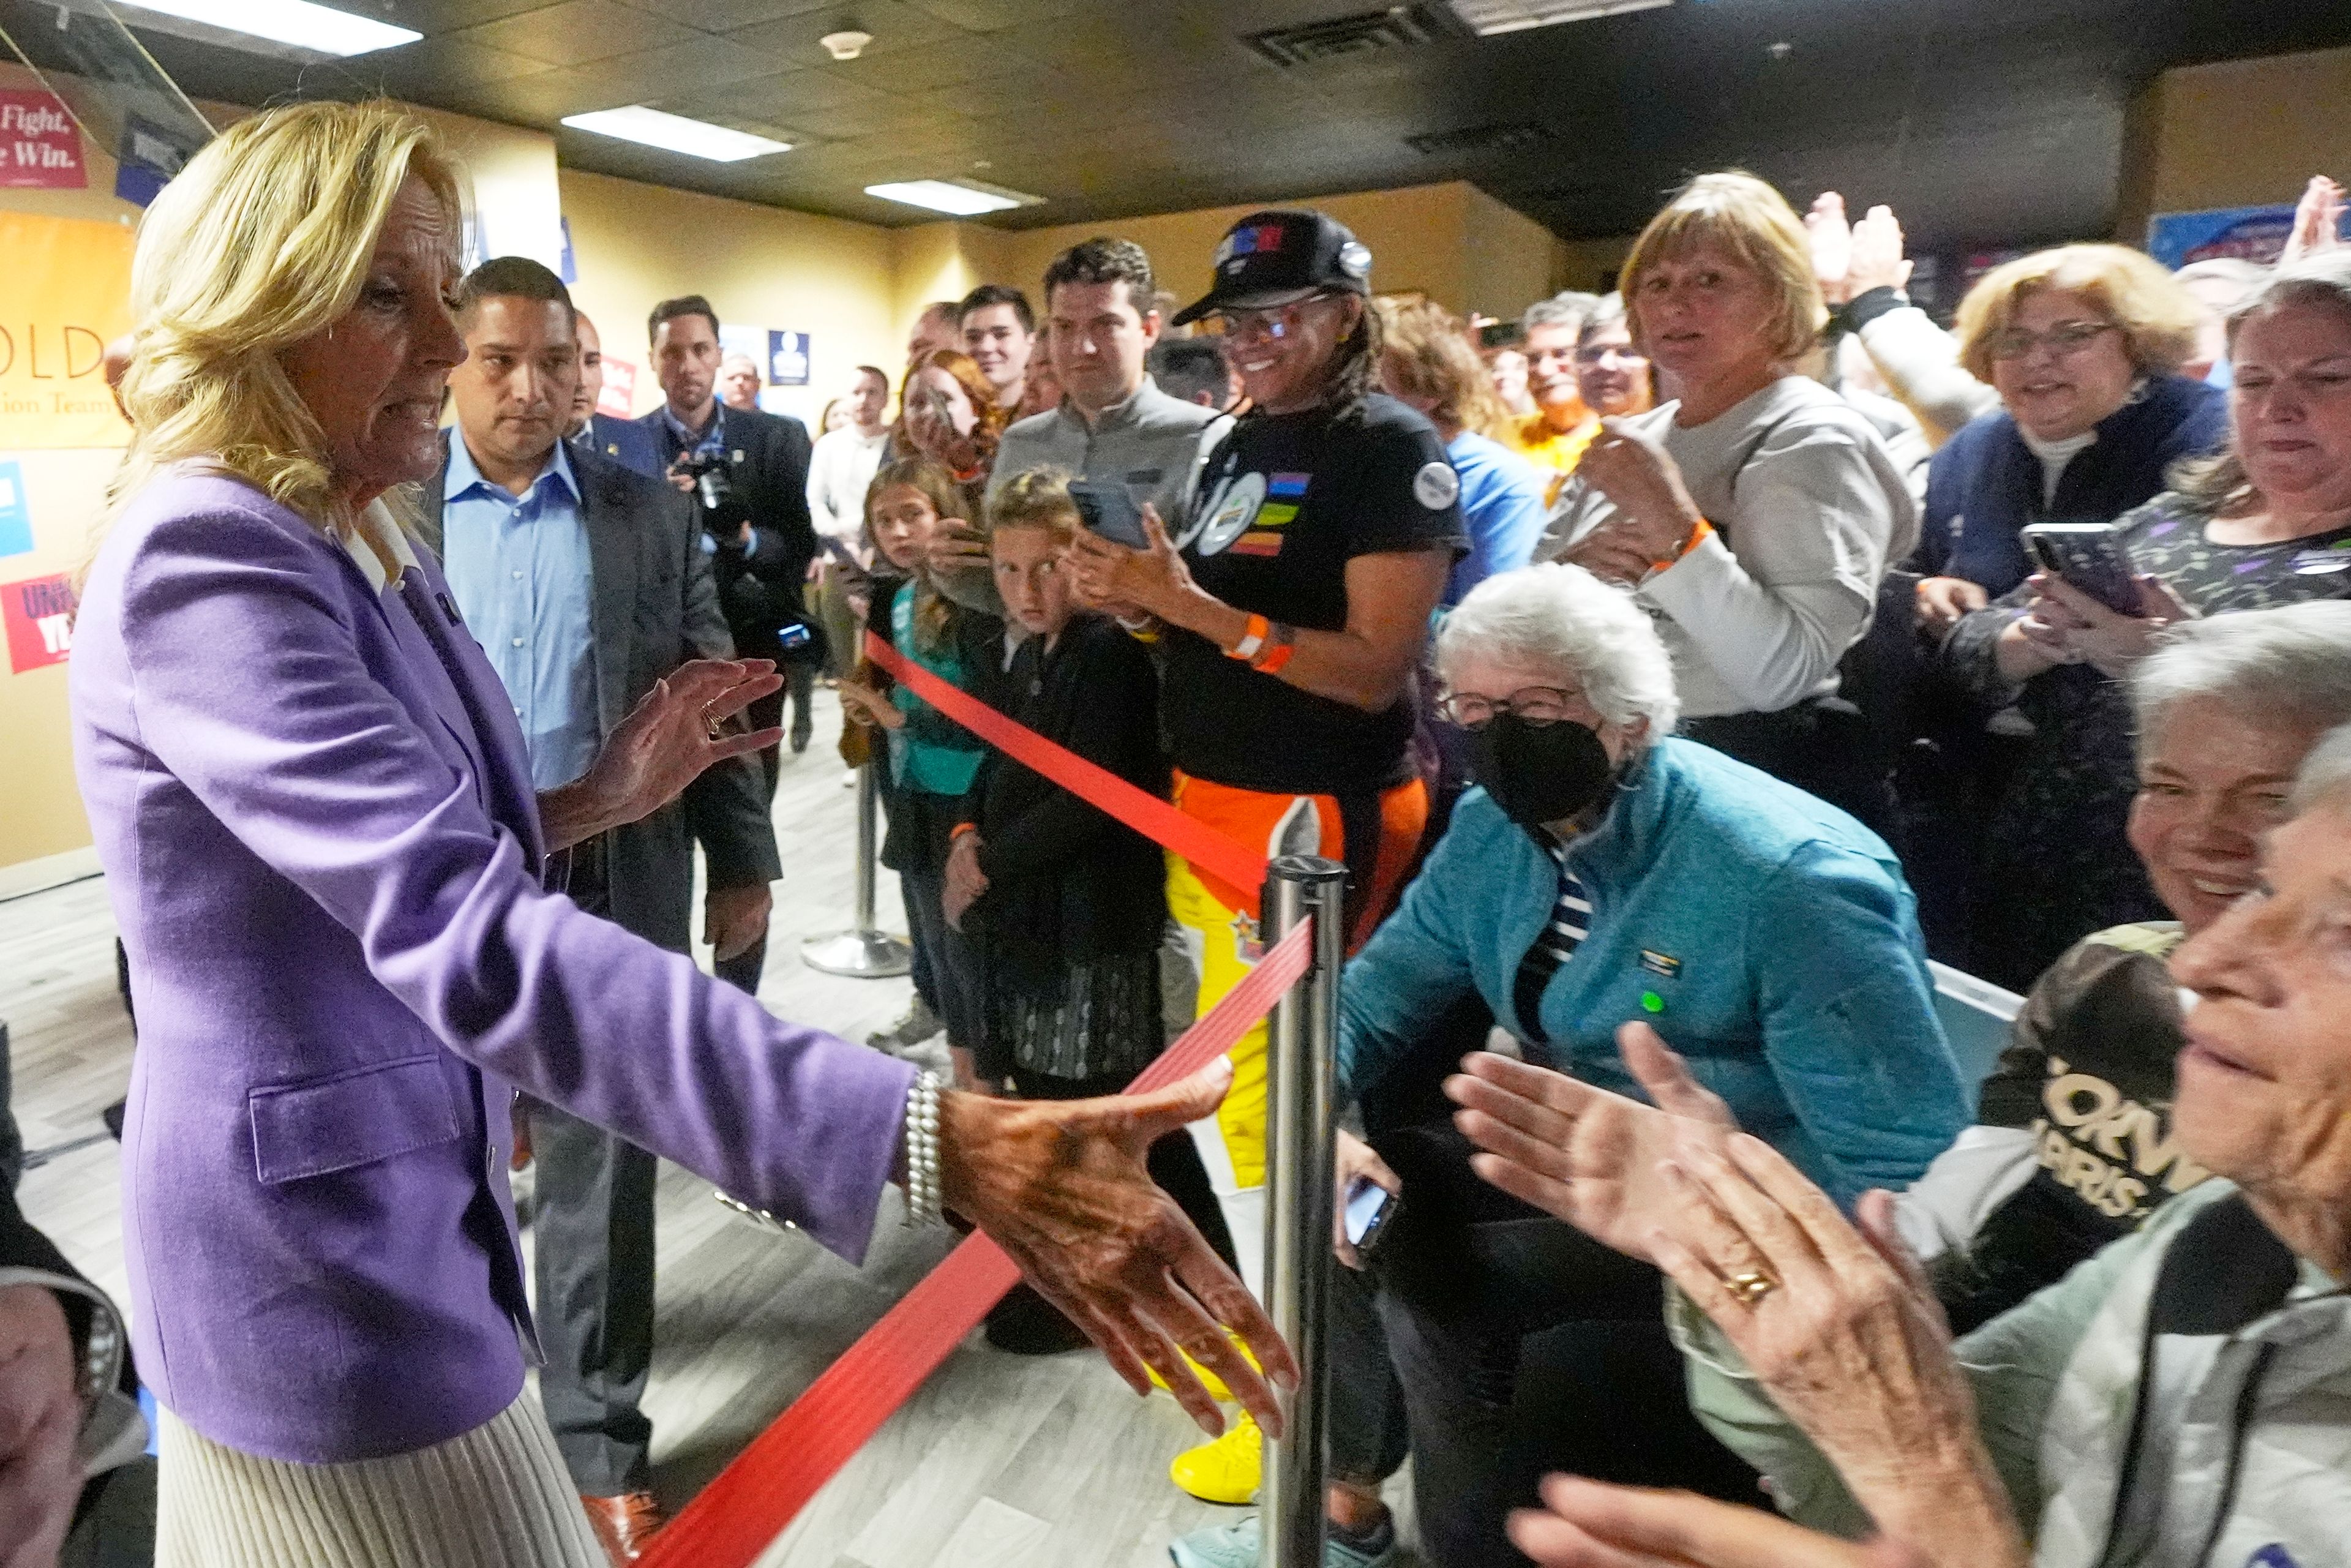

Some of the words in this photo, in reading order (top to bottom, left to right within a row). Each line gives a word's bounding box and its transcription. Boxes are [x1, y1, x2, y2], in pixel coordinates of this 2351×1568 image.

[2, 103, 70, 138] Fight.
[15, 141, 76, 168] Win.
[48, 391, 111, 413] Team
[2034, 1119, 2149, 1217] RRIS
